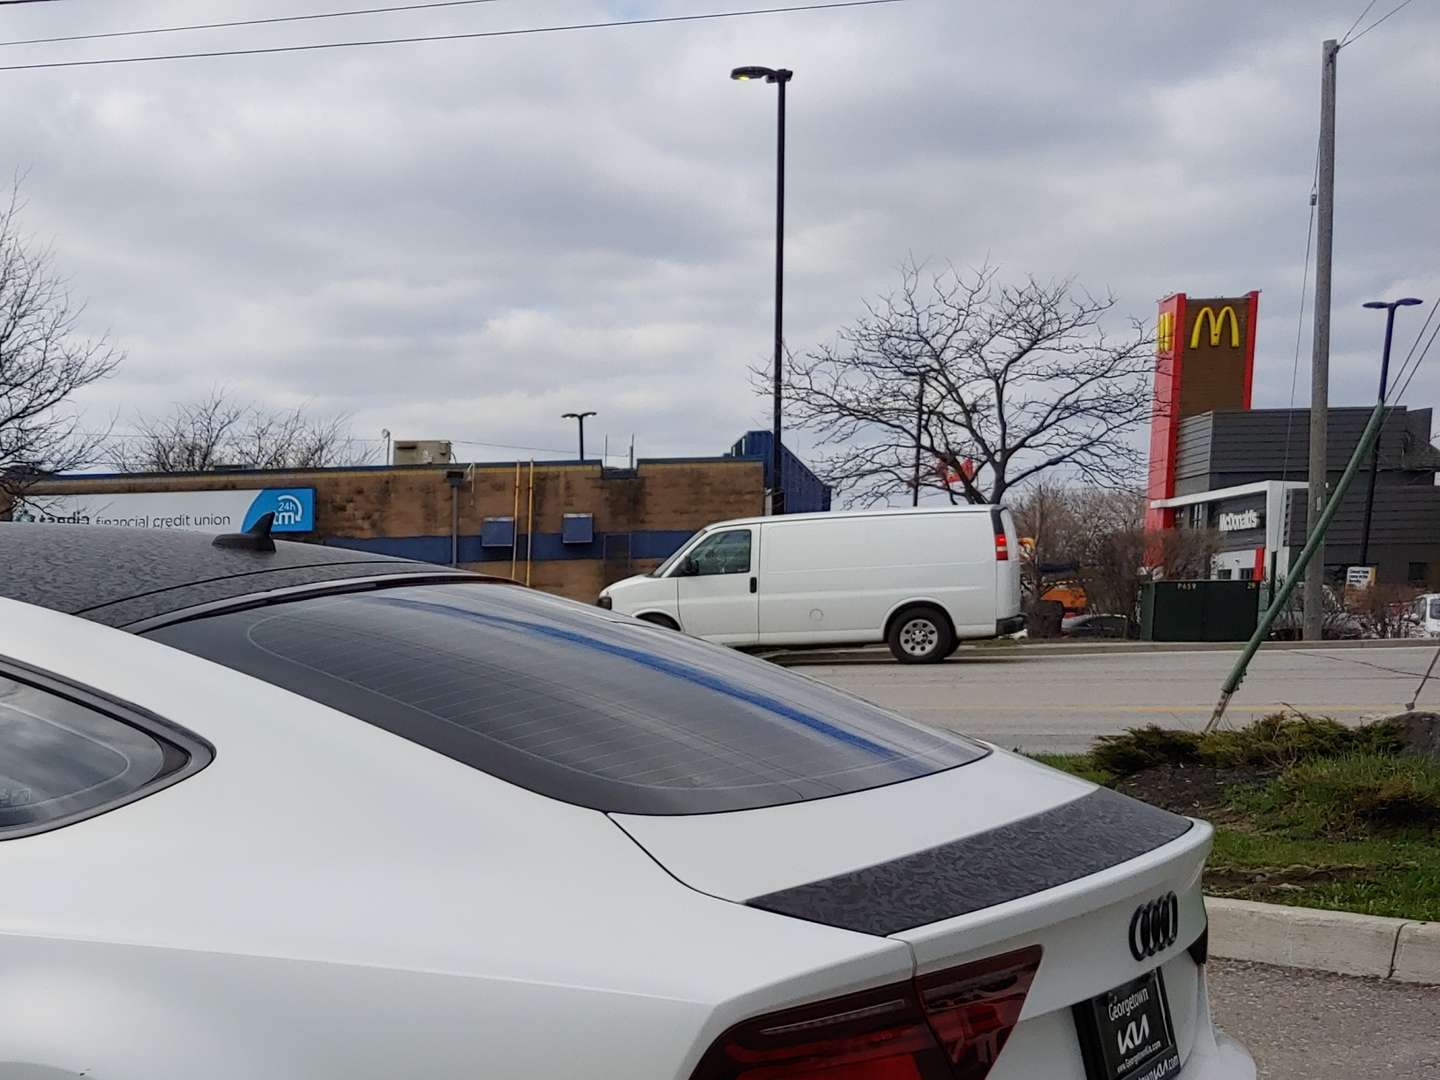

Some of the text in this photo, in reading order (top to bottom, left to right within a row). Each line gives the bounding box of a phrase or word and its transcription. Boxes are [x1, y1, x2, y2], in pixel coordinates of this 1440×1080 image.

[278, 500, 296, 511] 24h
[153, 514, 190, 528] credit
[194, 514, 231, 526] union
[273, 508, 294, 525] tm
[1108, 988, 1149, 1021] Georgetown
